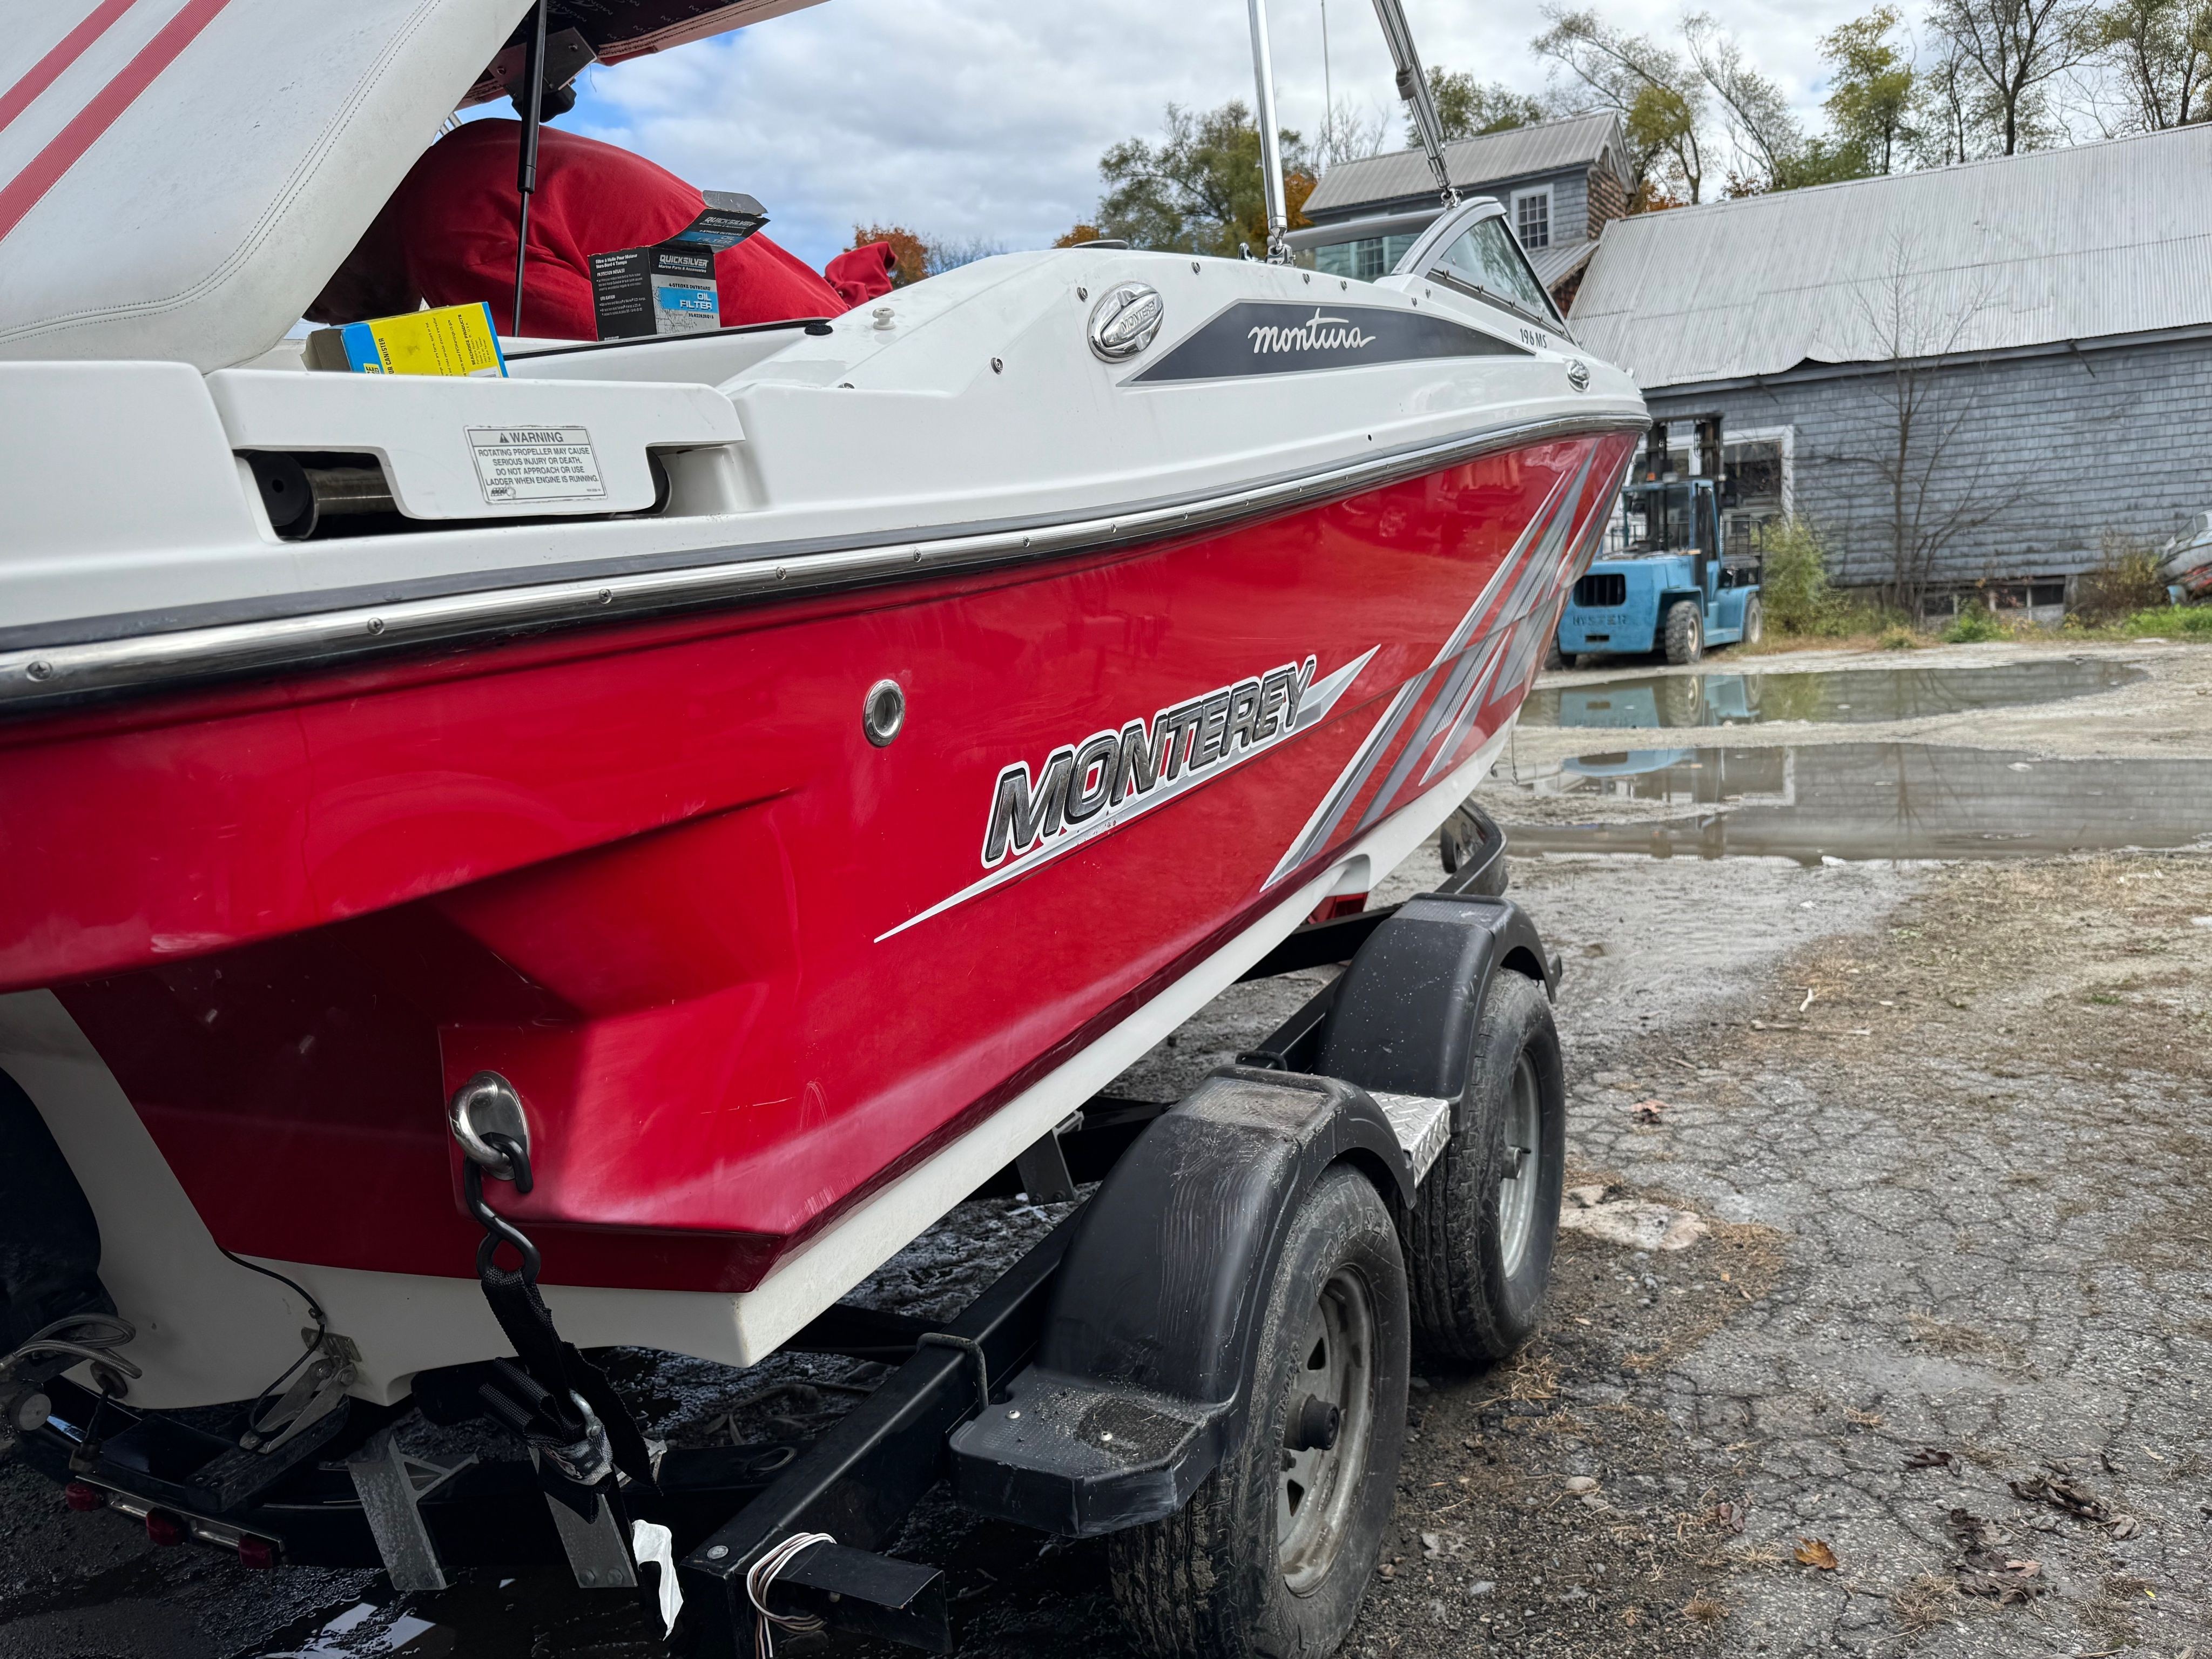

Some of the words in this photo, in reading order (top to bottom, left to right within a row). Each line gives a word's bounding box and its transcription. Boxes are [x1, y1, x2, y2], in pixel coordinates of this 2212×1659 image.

[704, 217, 756, 226] QUICKSILVER
[659, 254, 708, 267] QUICKSILVER
[697, 292, 712, 301] OIL
[680, 300, 712, 311] FILTER
[1120, 298, 1158, 334] MONTEREY
[1247, 307, 1375, 353] montura
[1520, 328, 1534, 346] 196
[1535, 332, 1547, 348] MS
[378, 338, 392, 365] CANISTER
[509, 431, 564, 443] WARNING
[478, 449, 512, 457] ROTATING
[512, 448, 553, 456] PROPELLER
[493, 458, 523, 466] SERIOUS
[496, 468, 507, 476] DO
[507, 467, 521, 475] NOT
[485, 478, 514, 486] LADDER
[536, 476, 561, 484] ENGINE
[569, 475, 599, 483] RUNNING.
[1573, 613, 1627, 627] HYSTER
[982, 655, 1316, 868] MONTEREY
